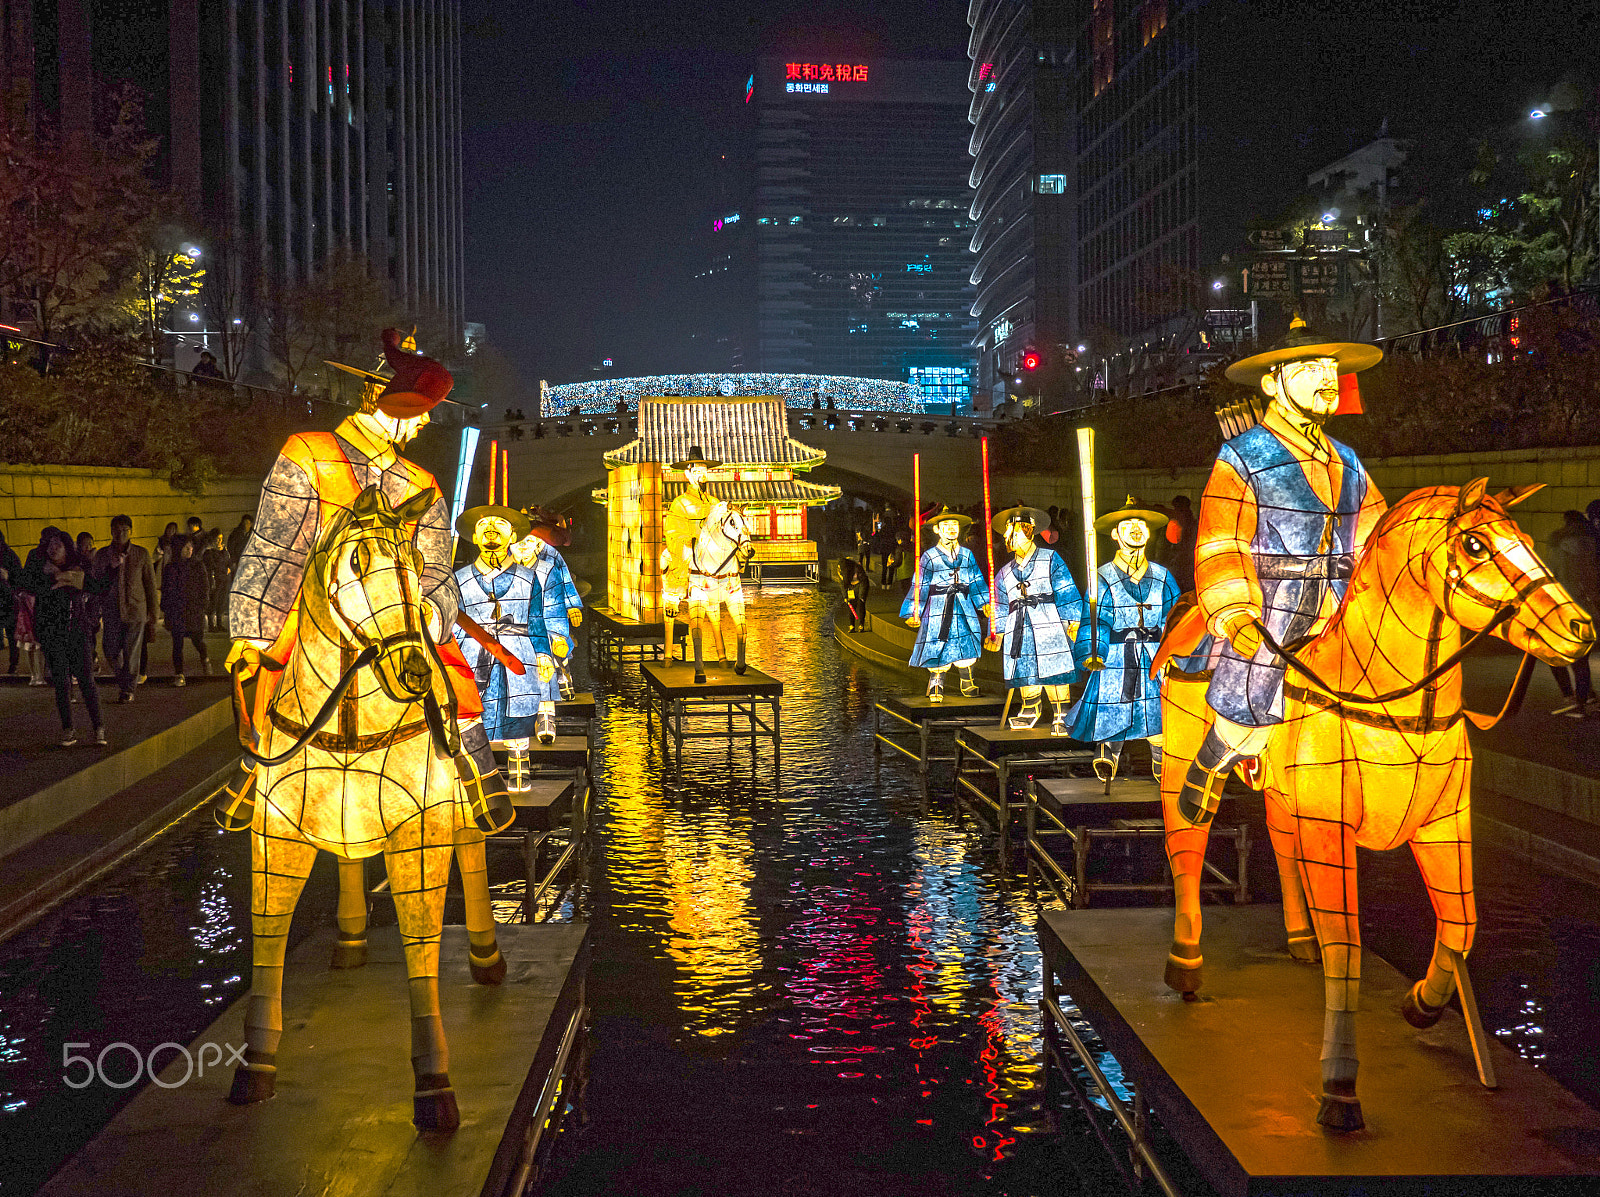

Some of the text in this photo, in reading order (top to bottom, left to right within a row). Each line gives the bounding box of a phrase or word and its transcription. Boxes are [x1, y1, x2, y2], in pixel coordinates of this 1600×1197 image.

[785, 62, 868, 82] 東和免稅店
[785, 82, 829, 94] 동화면세점
